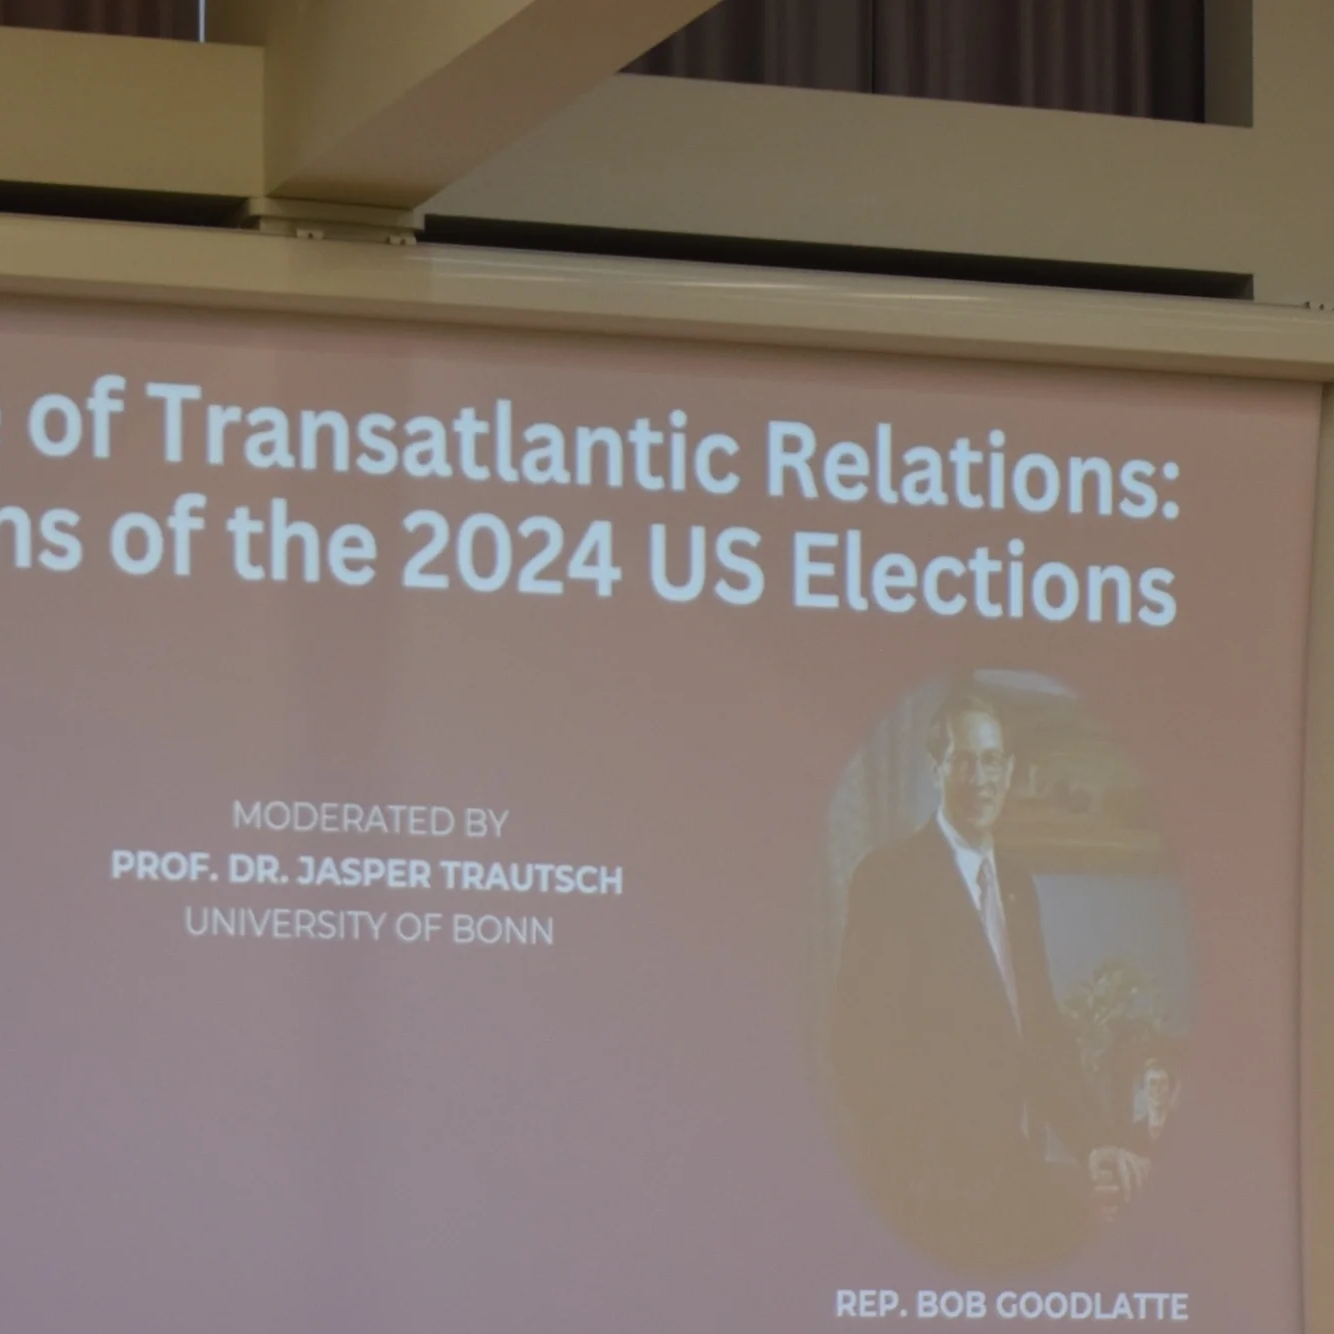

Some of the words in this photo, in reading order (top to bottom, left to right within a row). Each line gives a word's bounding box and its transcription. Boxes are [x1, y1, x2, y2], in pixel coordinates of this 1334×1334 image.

[29, 375, 125, 459] of
[147, 382, 740, 496] Transatlantic
[767, 420, 1180, 520] Relations:
[109, 493, 207, 577] of
[228, 498, 377, 586] the
[402, 509, 622, 597] 2024
[649, 523, 764, 606] US
[793, 530, 1177, 627] Elections
[233, 800, 454, 836] MODERATED
[466, 808, 509, 837] BY
[111, 849, 218, 881] PROF.
[229, 854, 289, 883] DR.
[297, 855, 431, 888] JASPER
[440, 860, 623, 895] TRAUTSCH
[185, 906, 387, 940] UNIVERSITY
[395, 912, 442, 942] OF
[452, 914, 554, 945] BONN
[836, 1289, 907, 1318] REP.
[917, 1290, 986, 1319] BOB
[996, 1292, 1189, 1320] GOODLATTE
